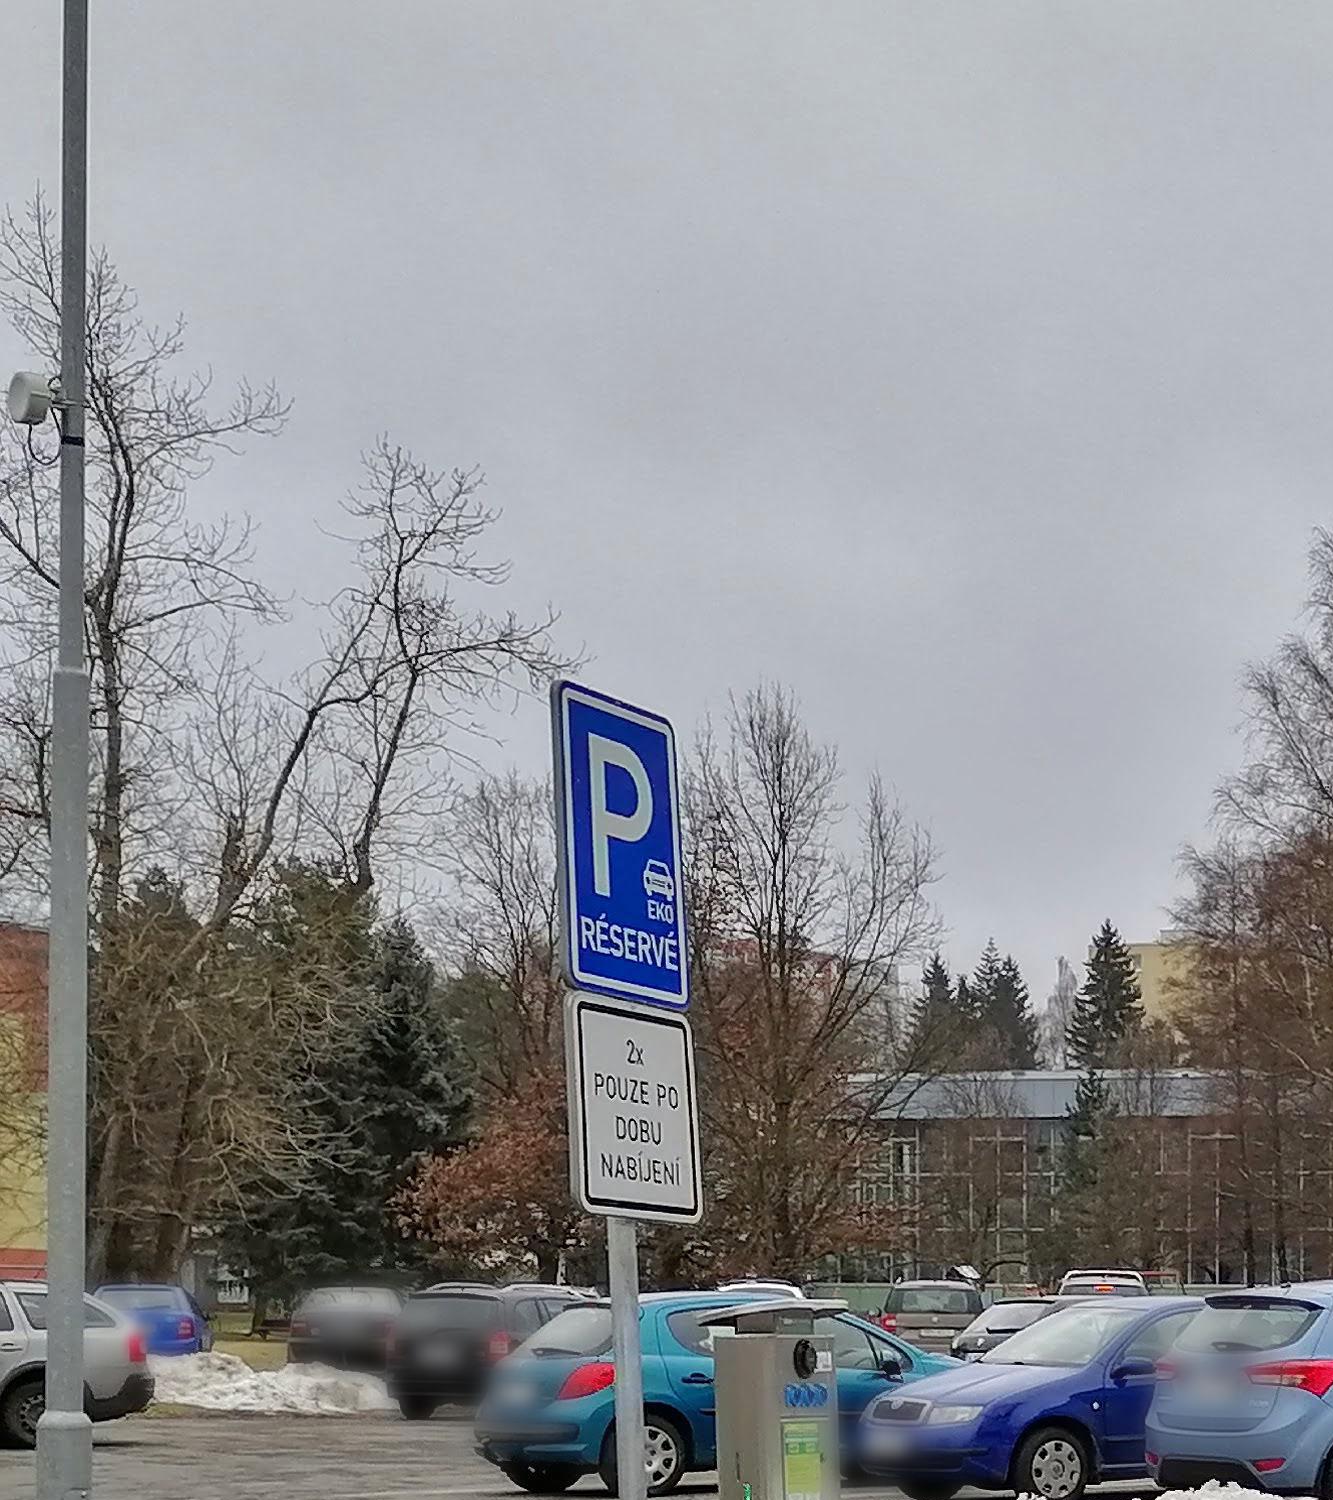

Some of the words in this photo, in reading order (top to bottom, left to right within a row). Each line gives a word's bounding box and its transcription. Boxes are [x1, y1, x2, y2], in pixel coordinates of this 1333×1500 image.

[588, 732, 654, 898] P
[647, 899, 675, 924] EKO
[580, 912, 679, 971] RÉSERVÉ
[626, 1039, 645, 1066] 2x
[594, 1072, 649, 1105] POUZE
[657, 1084, 679, 1110] PO
[615, 1115, 662, 1146] DOBU
[601, 1151, 680, 1186] NABÍJENÍ
